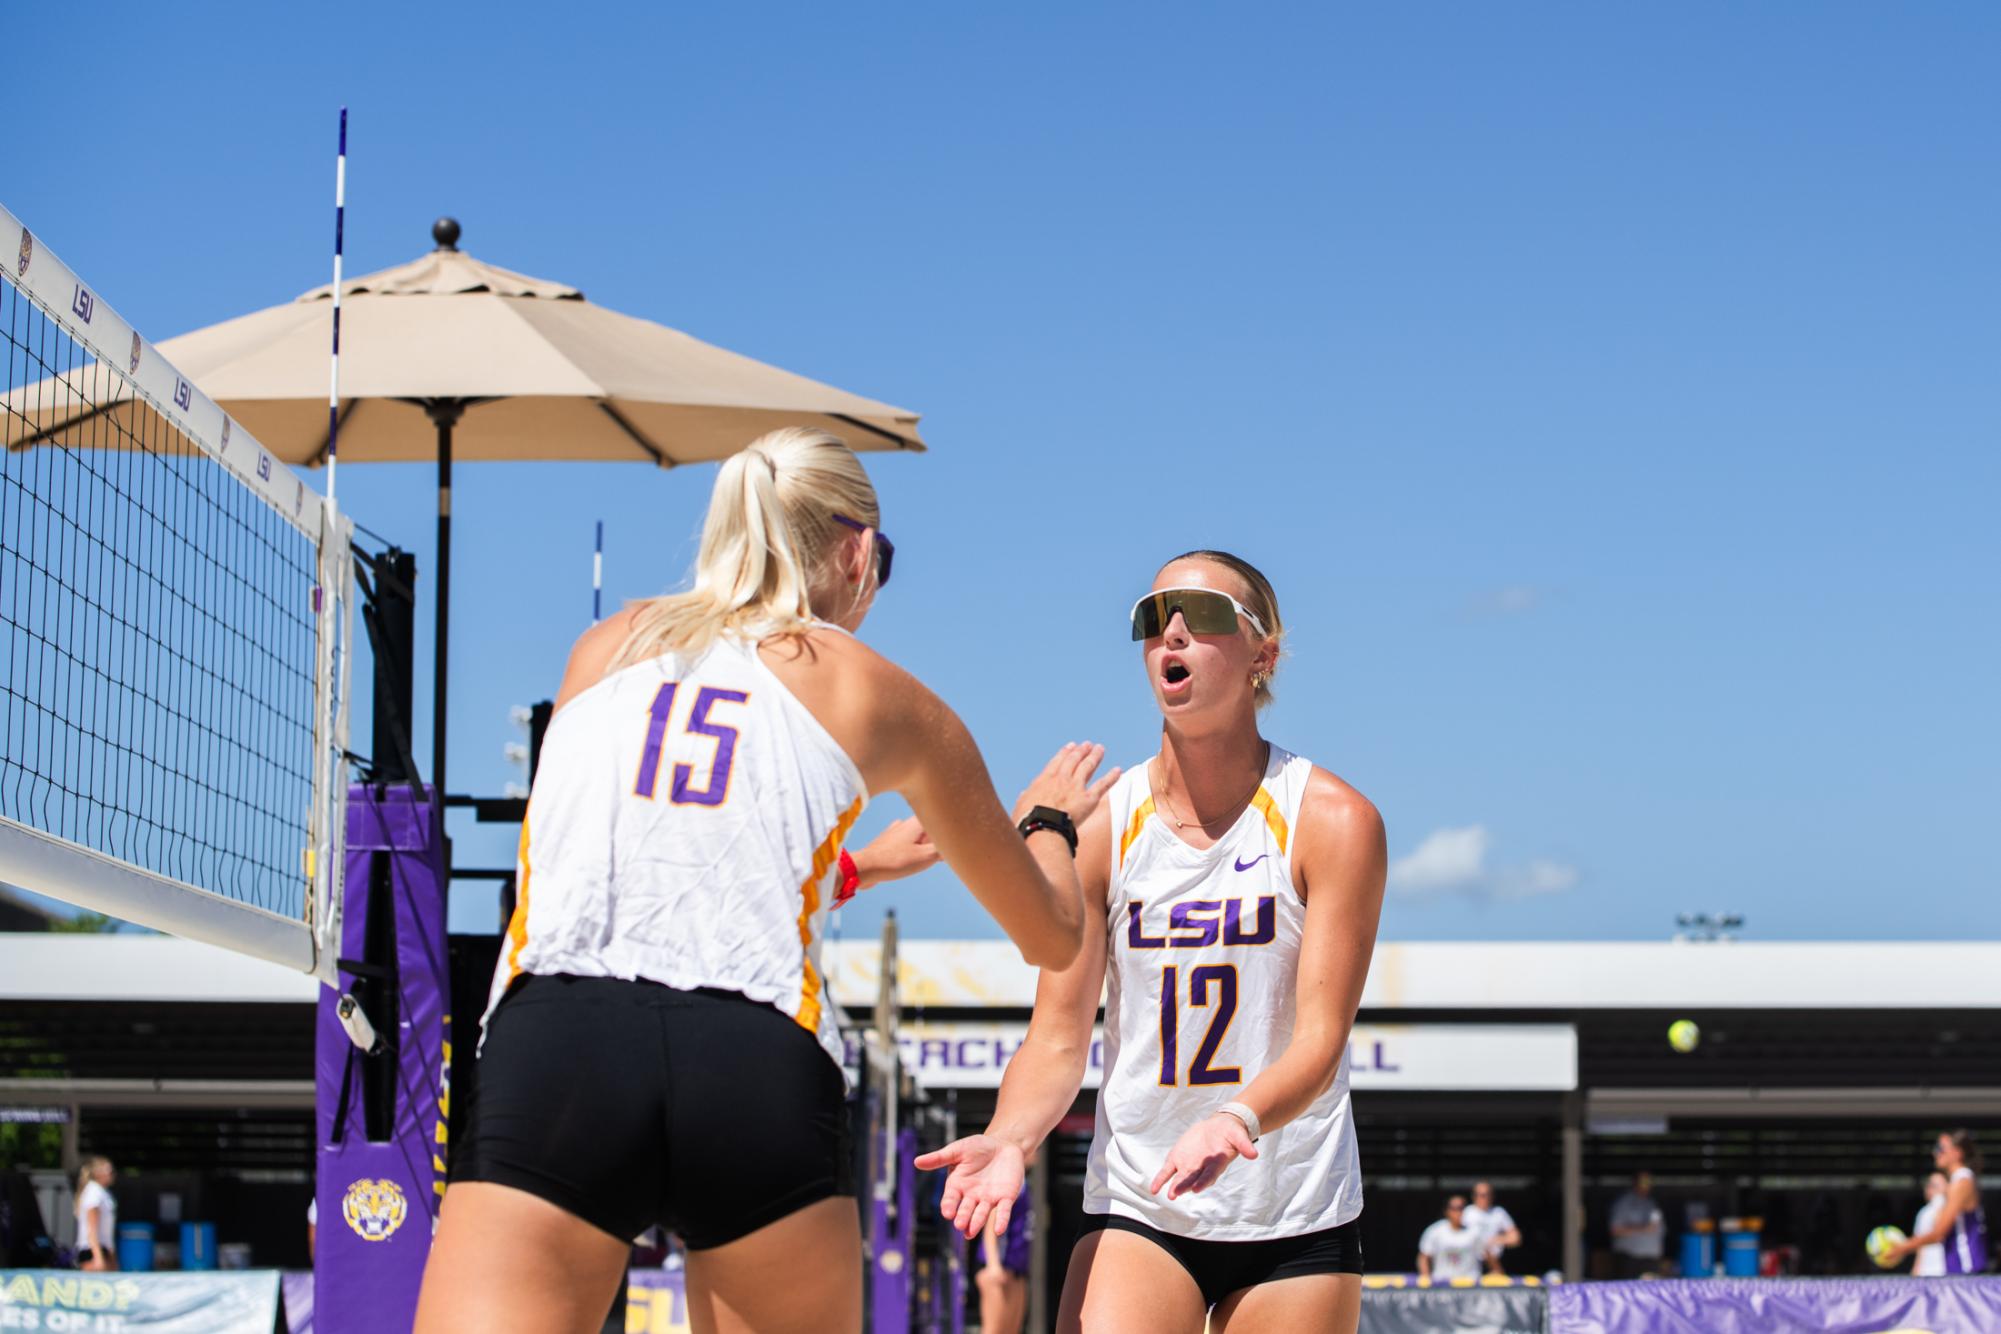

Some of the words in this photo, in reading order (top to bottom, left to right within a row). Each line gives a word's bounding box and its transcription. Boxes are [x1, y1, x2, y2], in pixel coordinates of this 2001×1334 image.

[72, 283, 94, 324] LSU
[173, 376, 192, 412] LSU
[257, 450, 272, 482] LSU
[632, 680, 752, 807] 15
[1127, 895, 1277, 950] LSU
[1158, 963, 1242, 1087] 12
[0, 1274, 141, 1312] AND?
[46, 1309, 90, 1333] OF
